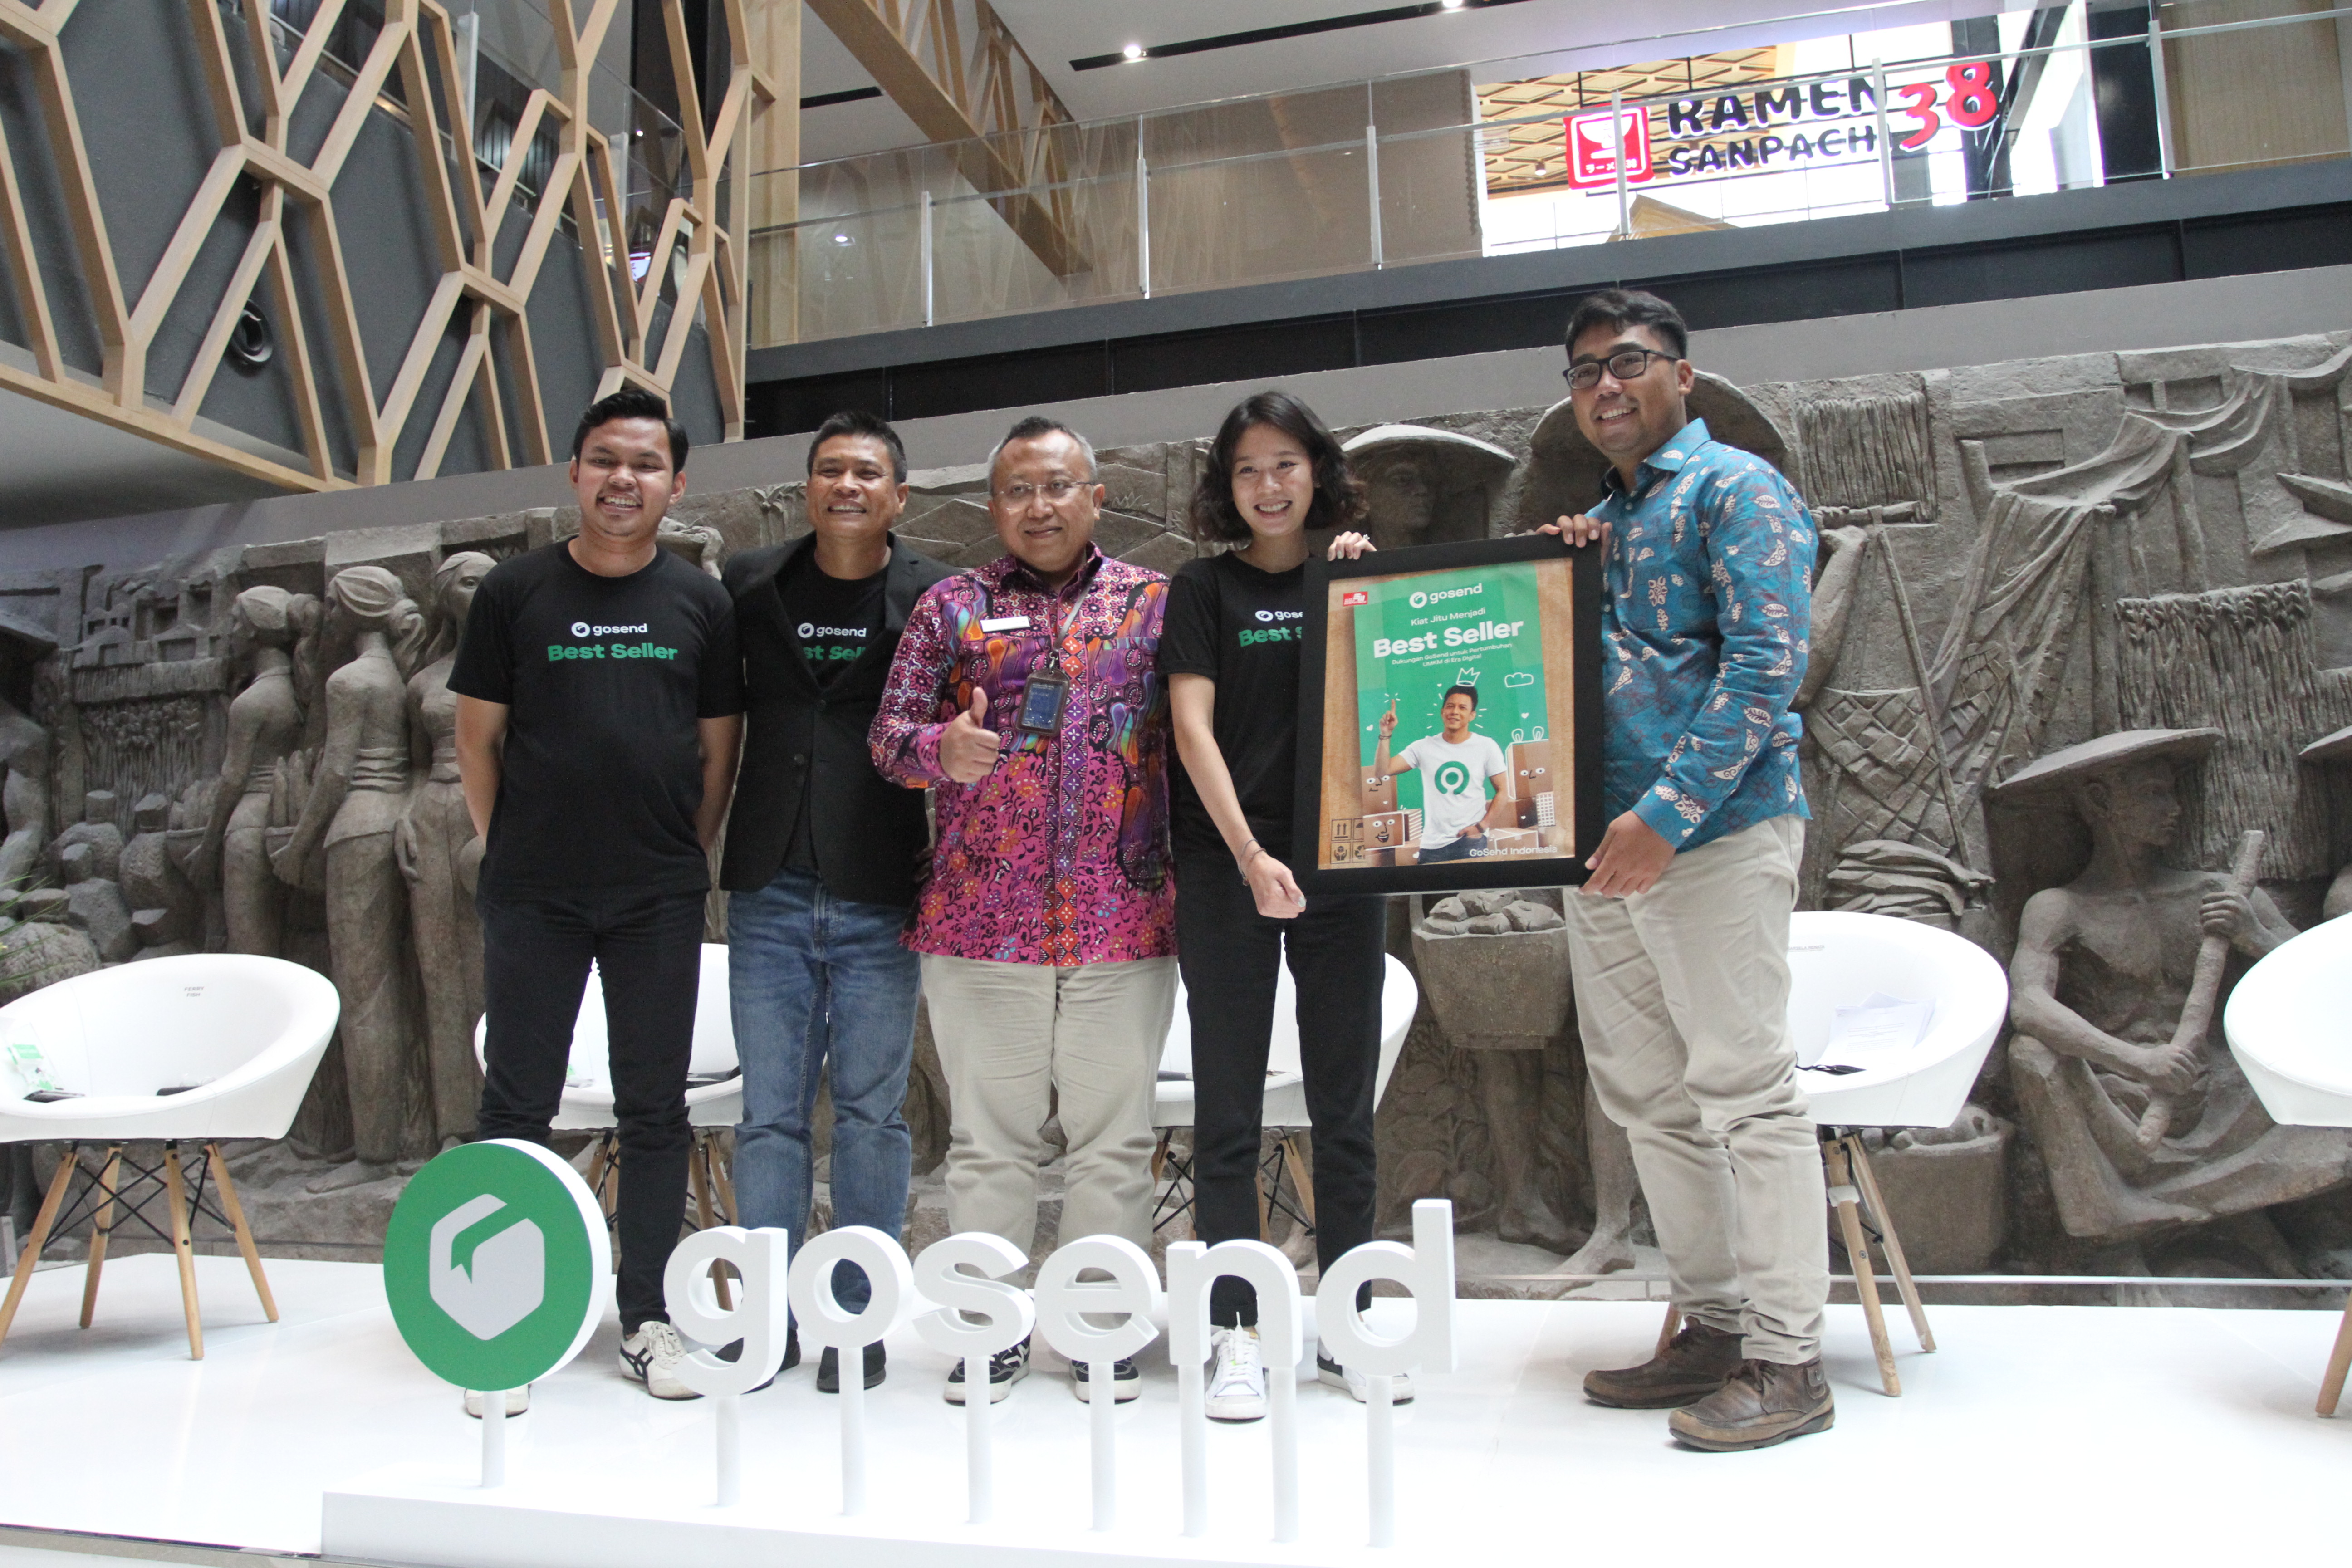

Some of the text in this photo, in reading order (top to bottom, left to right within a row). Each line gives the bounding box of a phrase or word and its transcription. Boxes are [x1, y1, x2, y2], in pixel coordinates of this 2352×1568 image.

[1668, 62, 1997, 150] RAMEN 38
[1669, 124, 1892, 176] SANPACH
[1429, 583, 1483, 604] gosend
[1411, 607, 1486, 626] Kiat Jitu Menjadi
[593, 623, 648, 636] gosend
[816, 627, 867, 637] gosend
[1238, 627, 1292, 647] Best
[1374, 621, 1524, 658] Best Seller
[548, 642, 678, 661] Best Seller
[1392, 656, 1423, 665] Dukungan
[1424, 652, 1449, 660] GoSend
[1469, 643, 1512, 654] Pertumbuhan
[1470, 845, 1558, 857] GoSend Indonesia
[662, 1198, 1458, 1397] gosend
